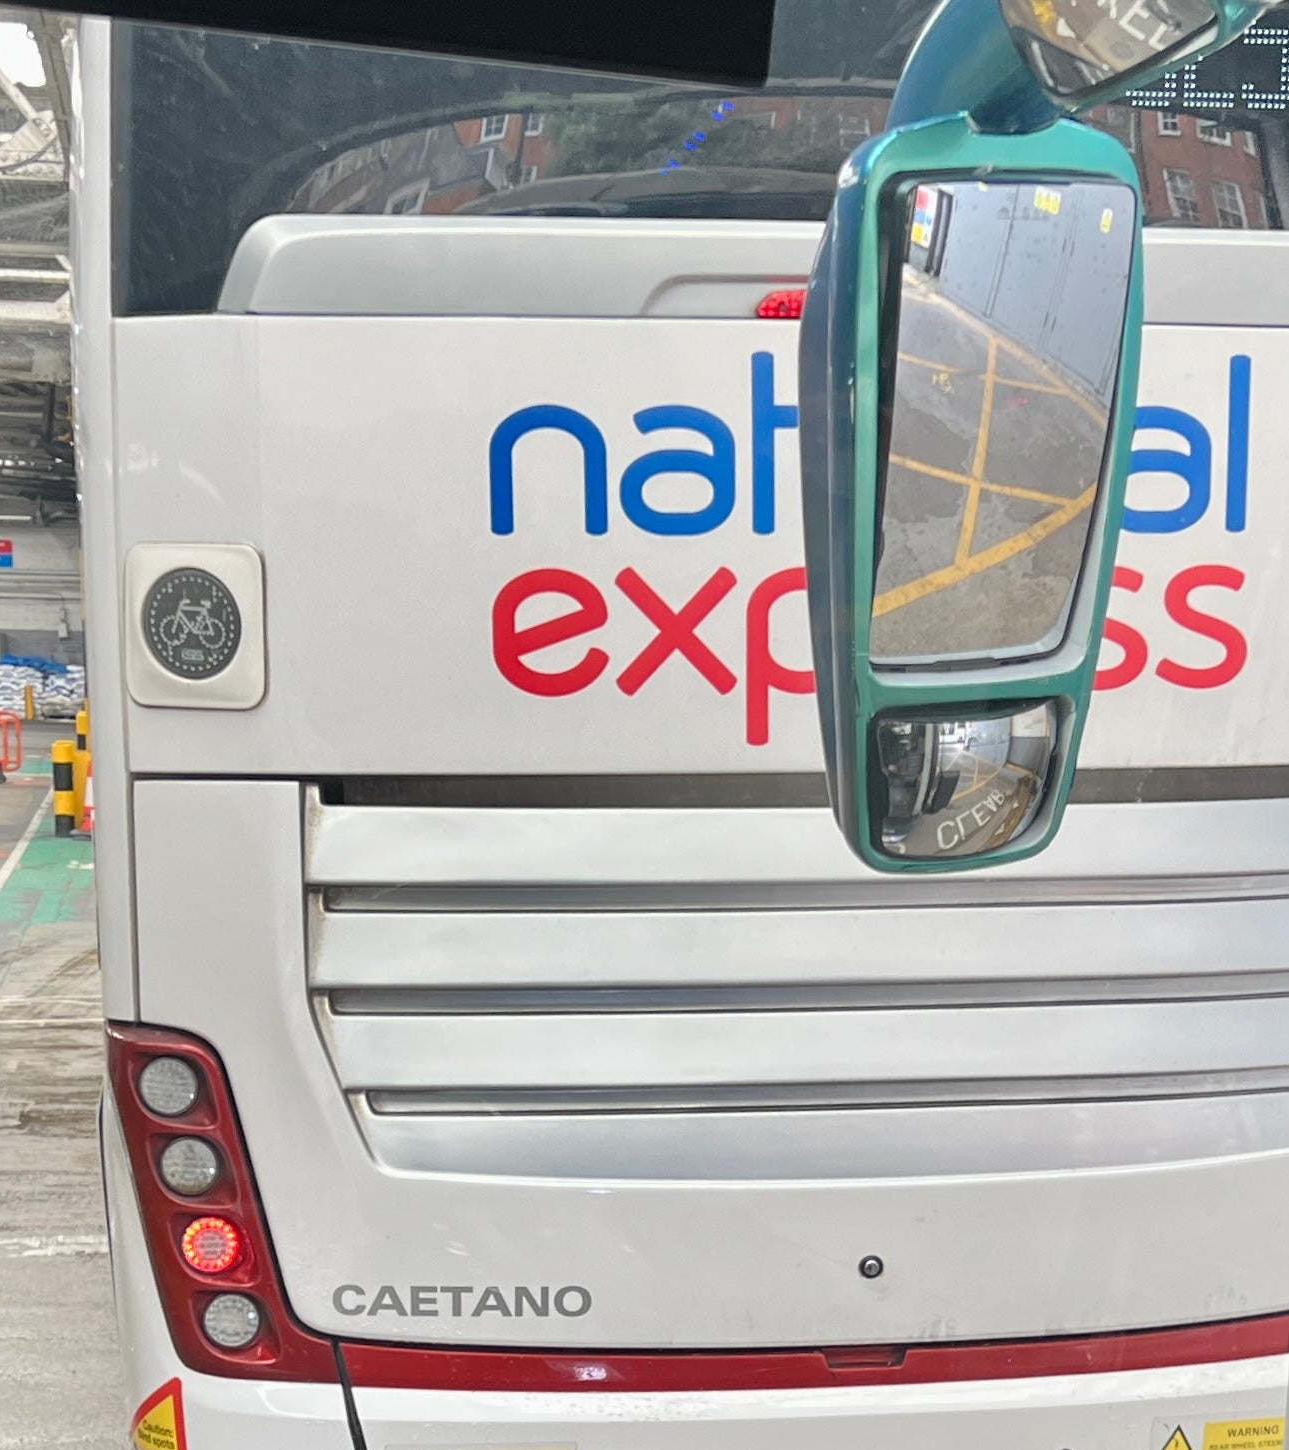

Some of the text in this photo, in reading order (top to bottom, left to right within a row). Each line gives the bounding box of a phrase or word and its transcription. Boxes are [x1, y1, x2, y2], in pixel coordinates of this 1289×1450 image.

[489, 352, 1251, 536] natal
[491, 563, 1248, 746] expss
[332, 1284, 592, 1317] CAETANO
[1227, 1425, 1279, 1438] WARNING
[153, 1438, 175, 1450] spots
[1231, 1442, 1256, 1450] WHEEL
